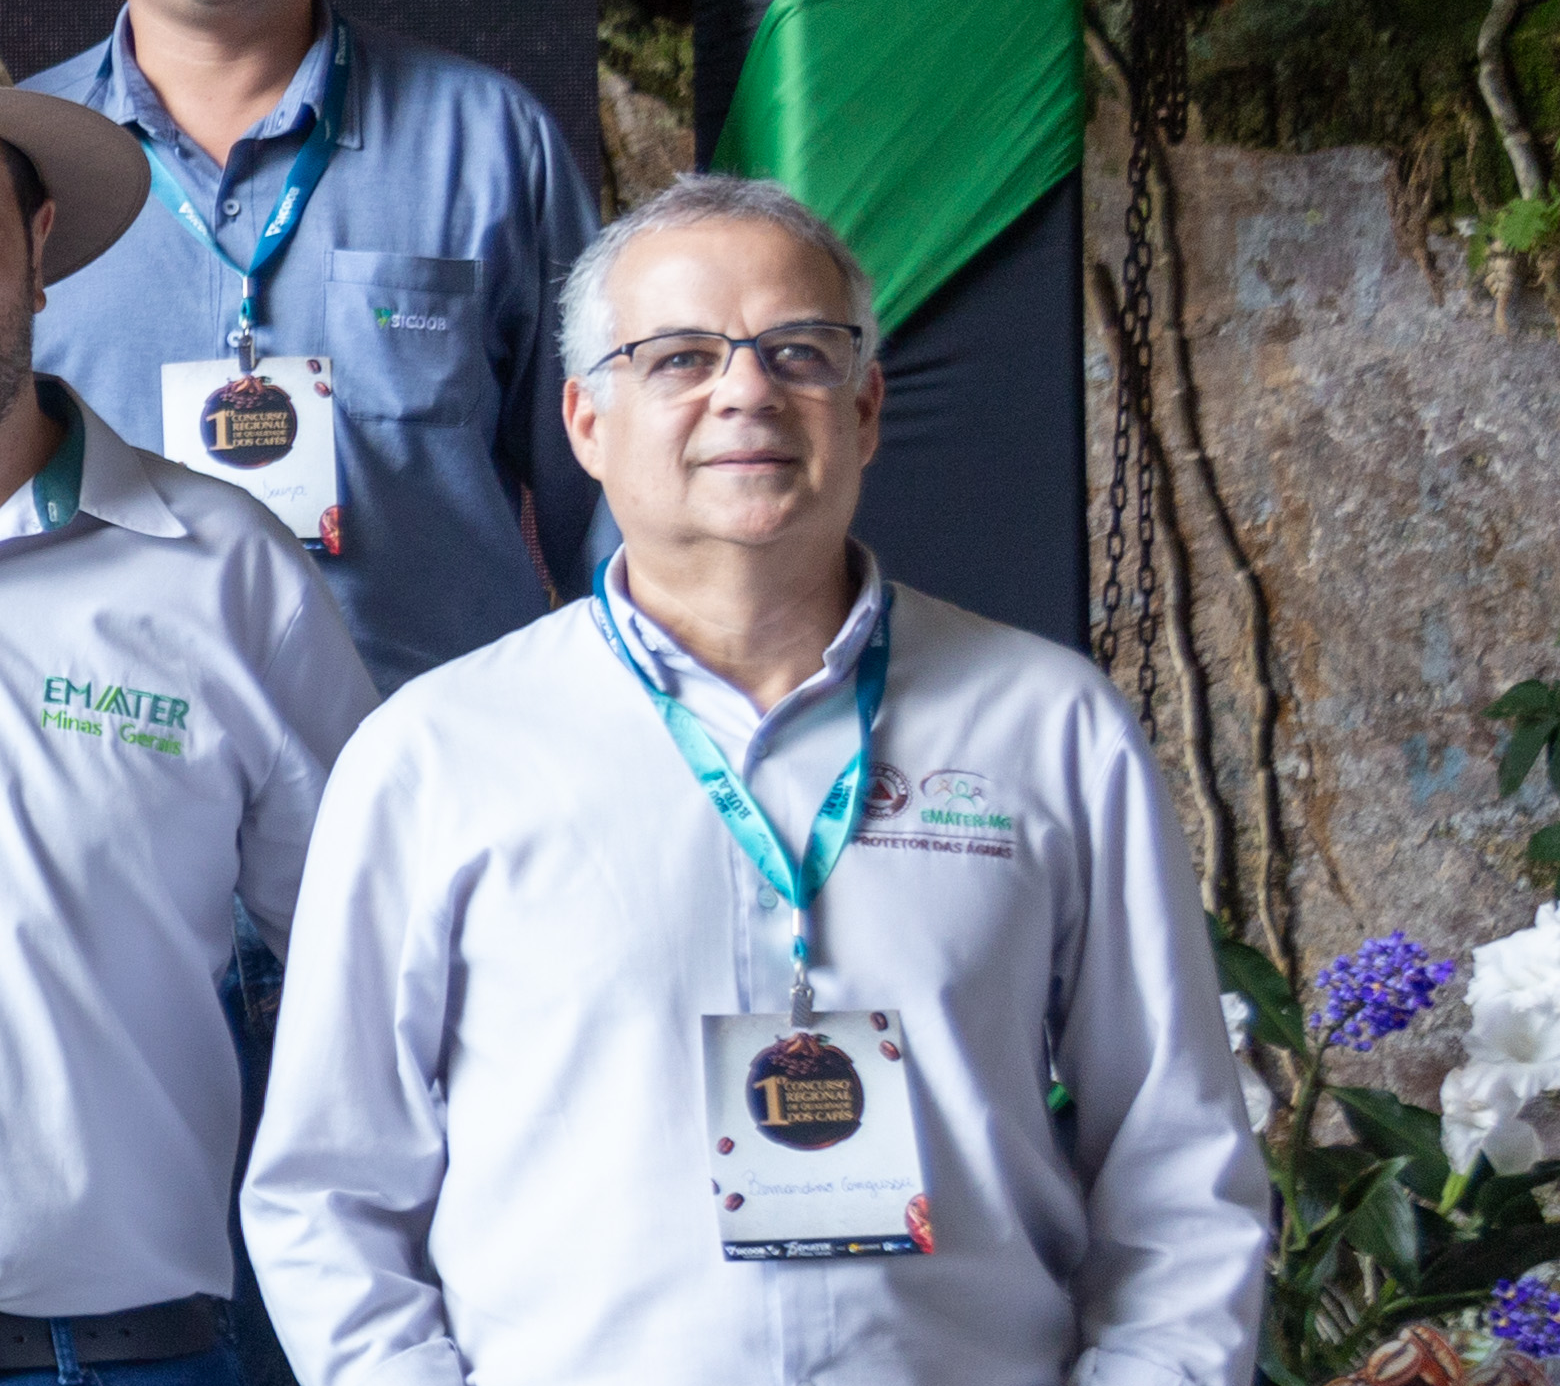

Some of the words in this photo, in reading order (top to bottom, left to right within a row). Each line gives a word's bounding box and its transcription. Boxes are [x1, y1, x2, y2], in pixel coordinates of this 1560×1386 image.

[391, 314, 447, 331] SICOOB
[43, 675, 190, 730] EMATER
[41, 708, 103, 737] Minas
[120, 722, 182, 757] Gerais
[932, 840, 963, 854] DAS
